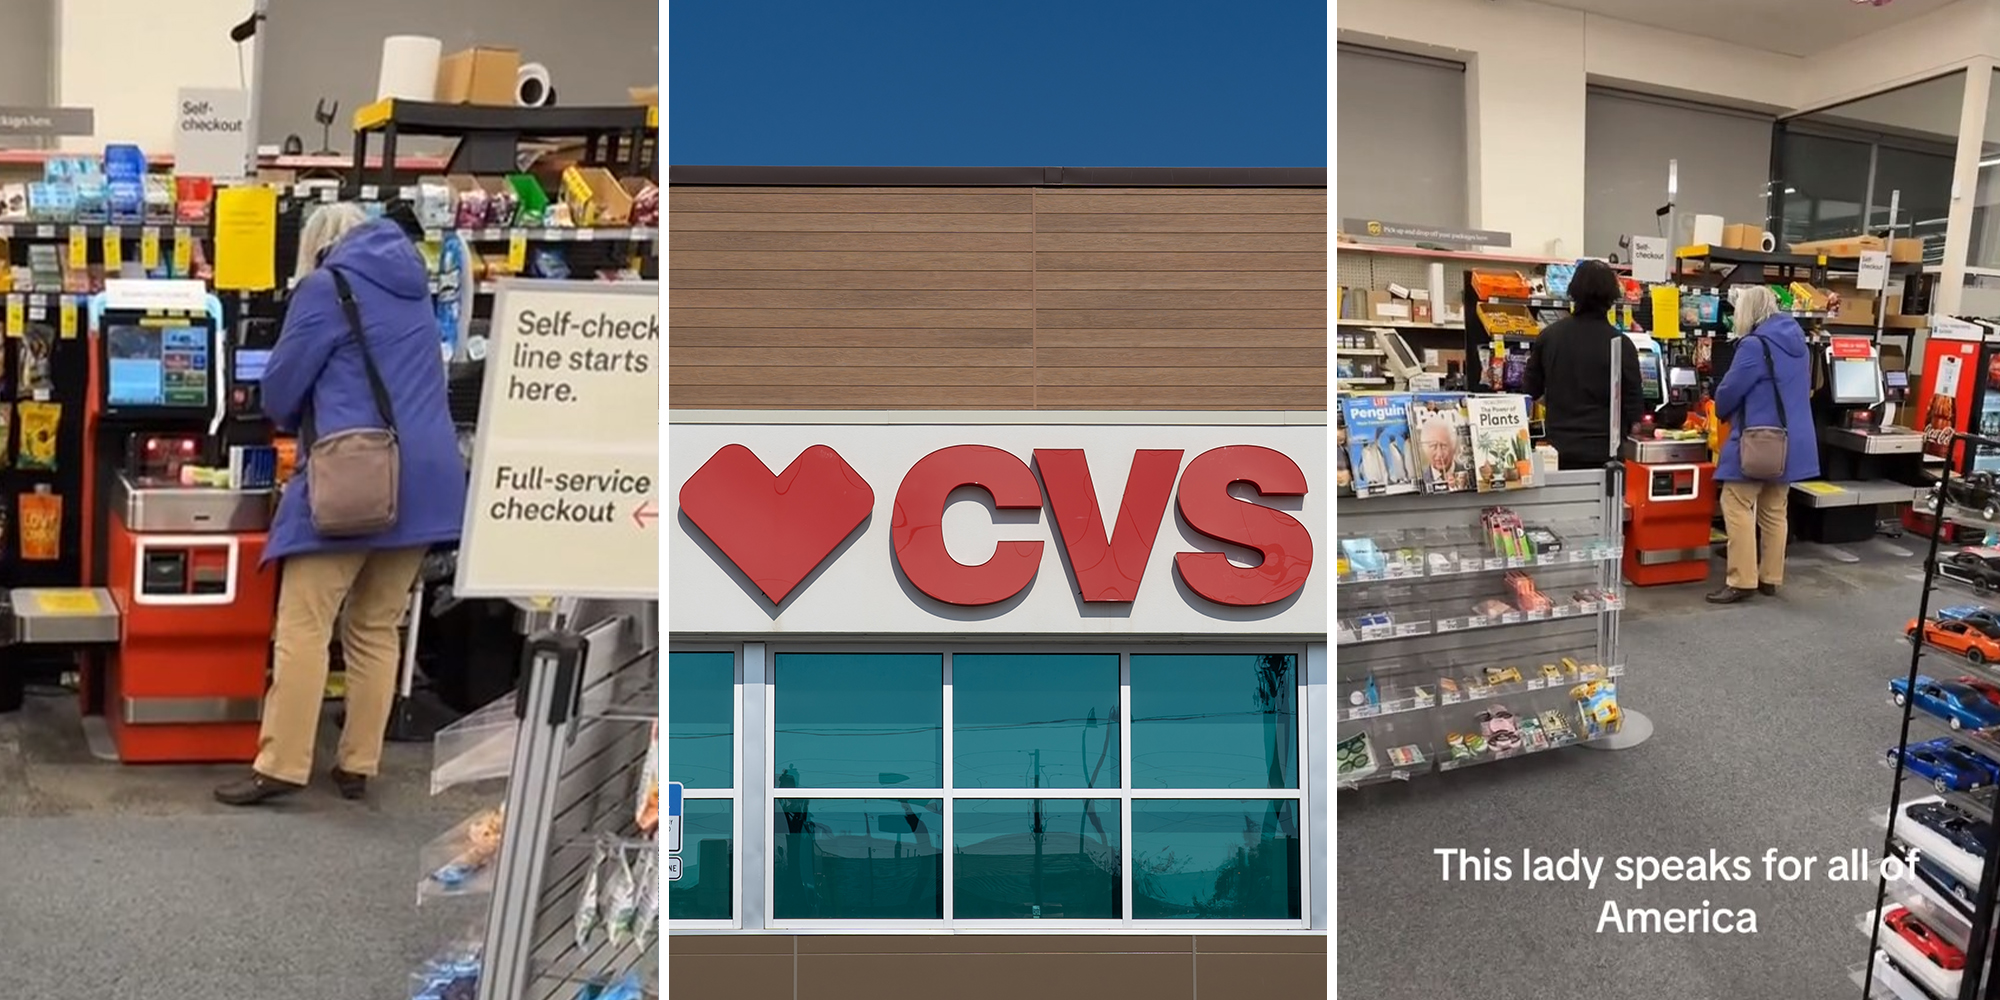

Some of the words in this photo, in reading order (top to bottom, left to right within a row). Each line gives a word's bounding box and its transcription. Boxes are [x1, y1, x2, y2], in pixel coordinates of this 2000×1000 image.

[182, 100, 213, 115] Self-
[181, 118, 242, 132] checkout
[1384, 226, 1396, 234] Pick
[1416, 229, 1430, 238] drop
[1635, 251, 1665, 260] checkout
[512, 342, 562, 370] line
[568, 348, 649, 373] starts
[507, 375, 578, 403] here.
[1479, 413, 1520, 426] Plants
[495, 466, 651, 494] Full-service
[490, 496, 616, 522] checkout
[892, 444, 1314, 607] CVS
